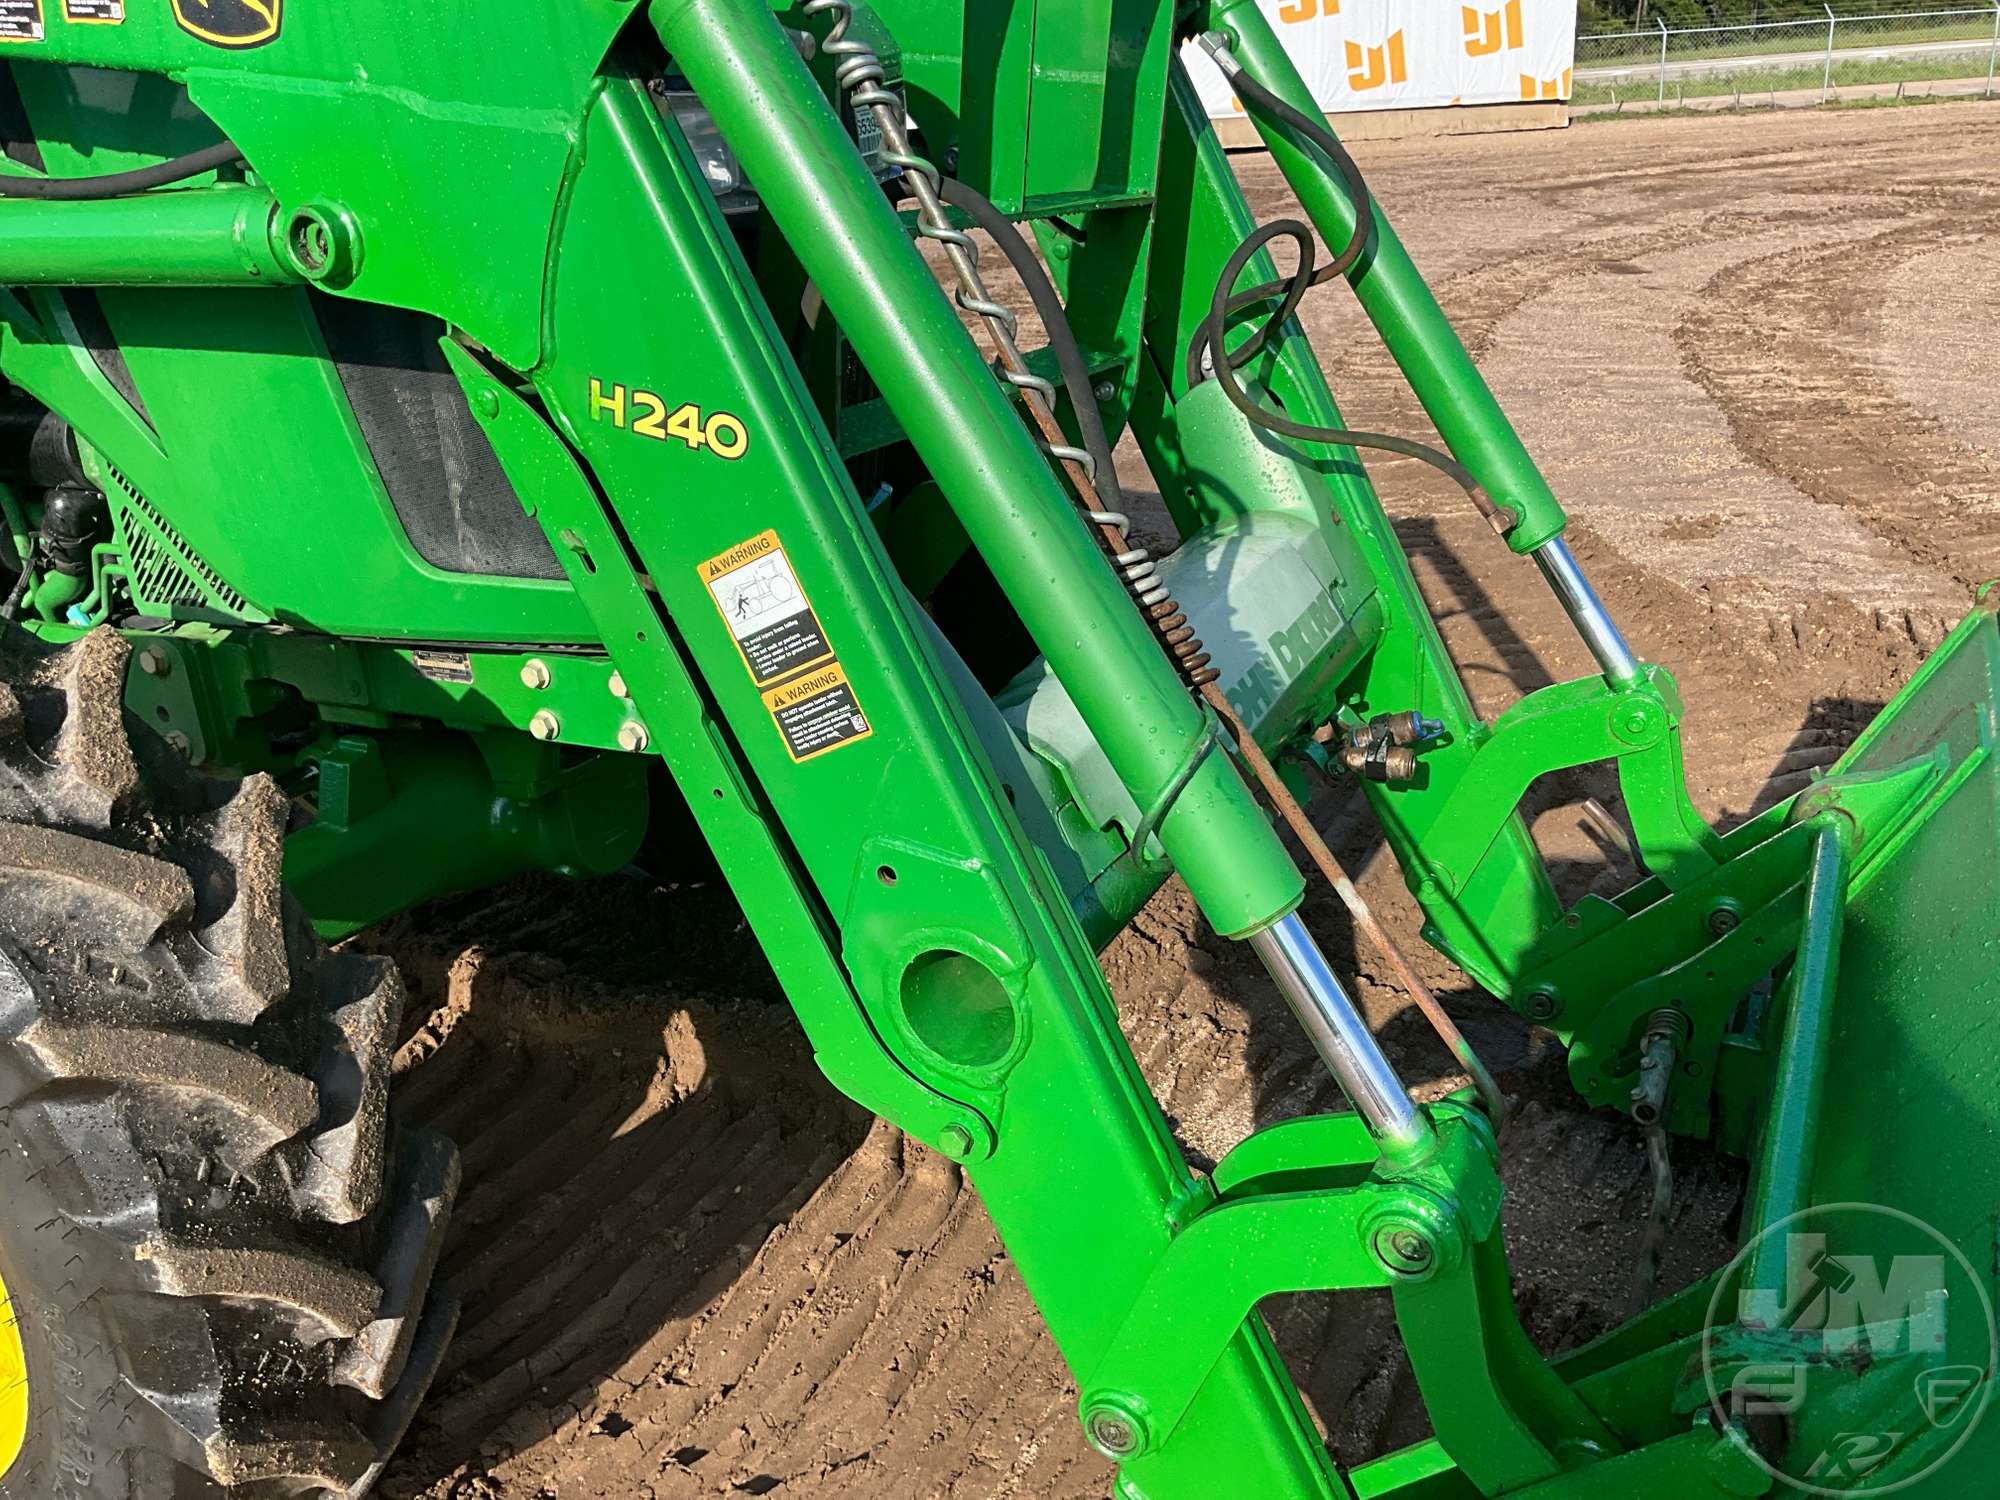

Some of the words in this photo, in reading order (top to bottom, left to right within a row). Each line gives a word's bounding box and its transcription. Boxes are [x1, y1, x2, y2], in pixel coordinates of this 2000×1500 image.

[589, 376, 749, 461] H240
[719, 537, 771, 570] WARNING
[785, 672, 837, 700] WARNING
